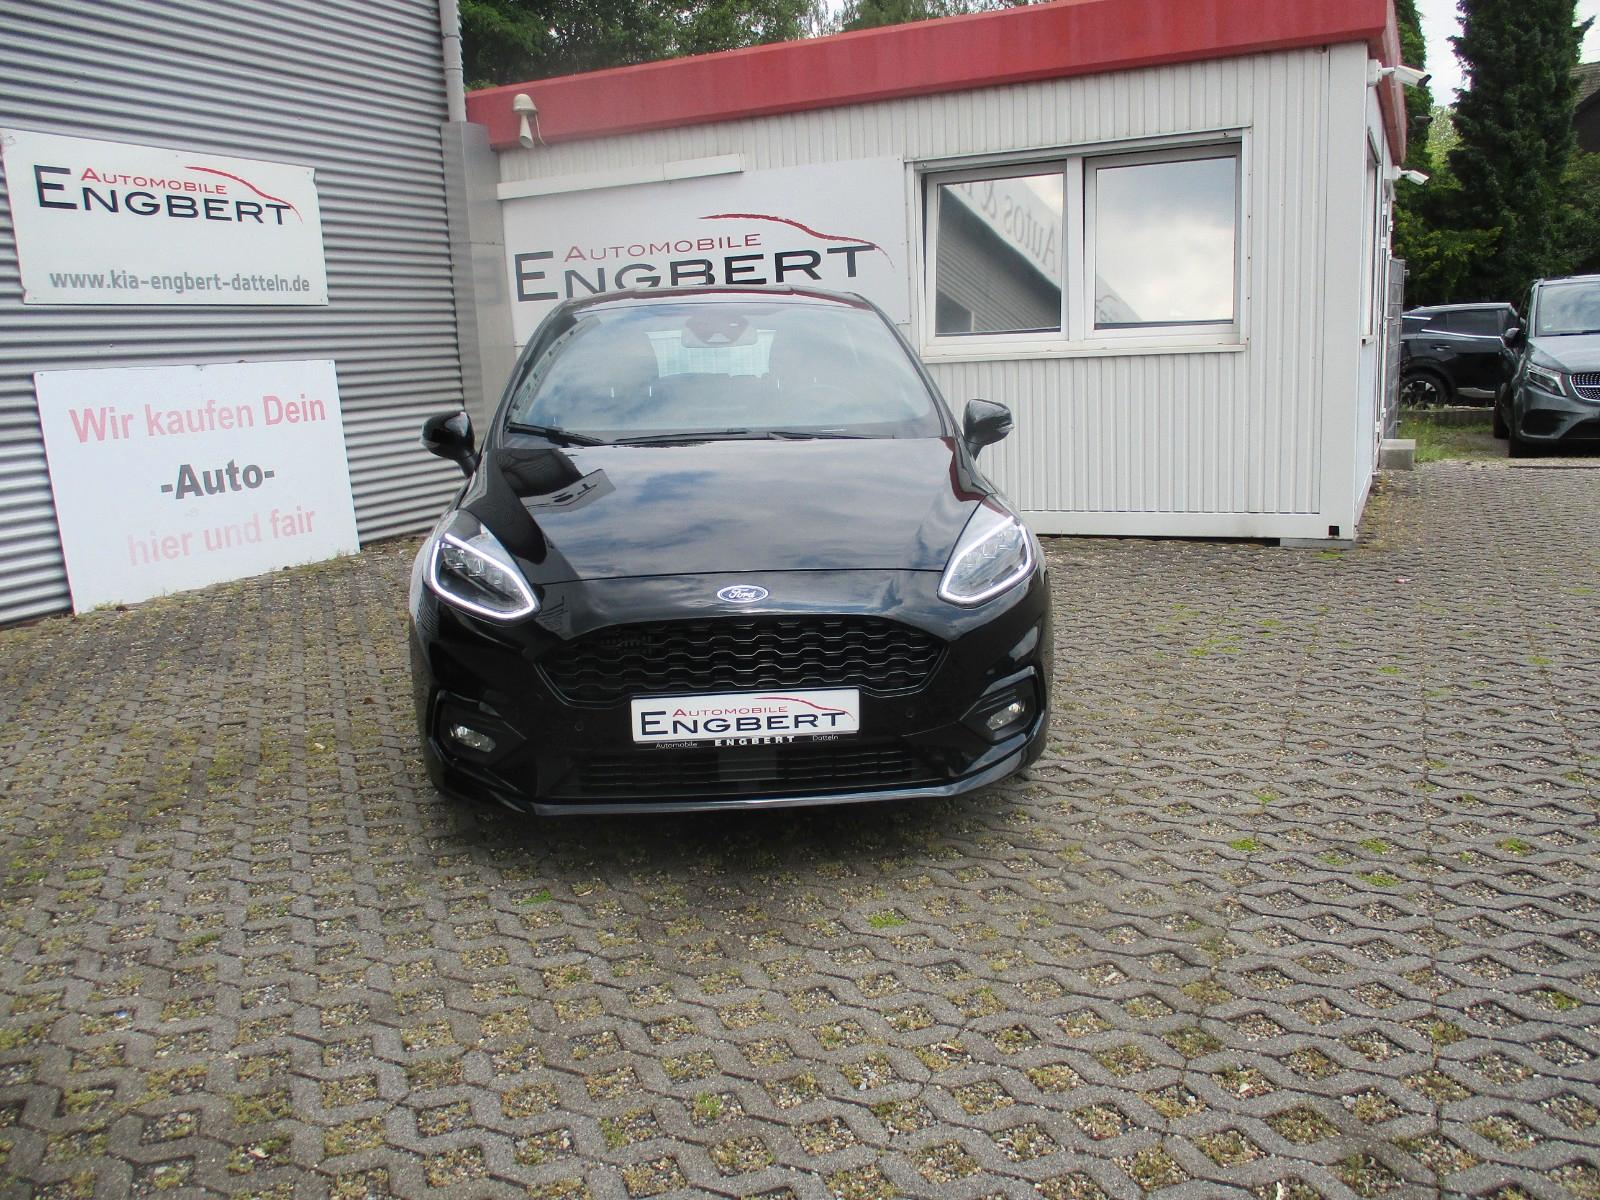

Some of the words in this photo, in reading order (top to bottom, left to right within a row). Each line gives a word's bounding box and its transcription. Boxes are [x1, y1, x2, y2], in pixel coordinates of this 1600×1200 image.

[34, 164, 291, 226] ENGBERT
[81, 168, 229, 195] AUTOMOBILE
[564, 234, 762, 263] AUTOMOBILE
[50, 270, 310, 294] www.kia-engbert-datteln.de
[515, 245, 876, 302] ENGBERT
[69, 406, 134, 443] Wir
[145, 400, 254, 437] kaufen
[262, 394, 326, 426] Dein
[161, 459, 275, 500] -Auto-
[127, 530, 193, 566] hier
[203, 513, 262, 552] und
[270, 506, 316, 539] fair
[640, 710, 846, 736] ENGBERT
[672, 705, 788, 718] AUTOMOBILE
[655, 741, 698, 749] Automobile
[714, 735, 795, 747] ENGBERT
[812, 734, 839, 742] Datteln
